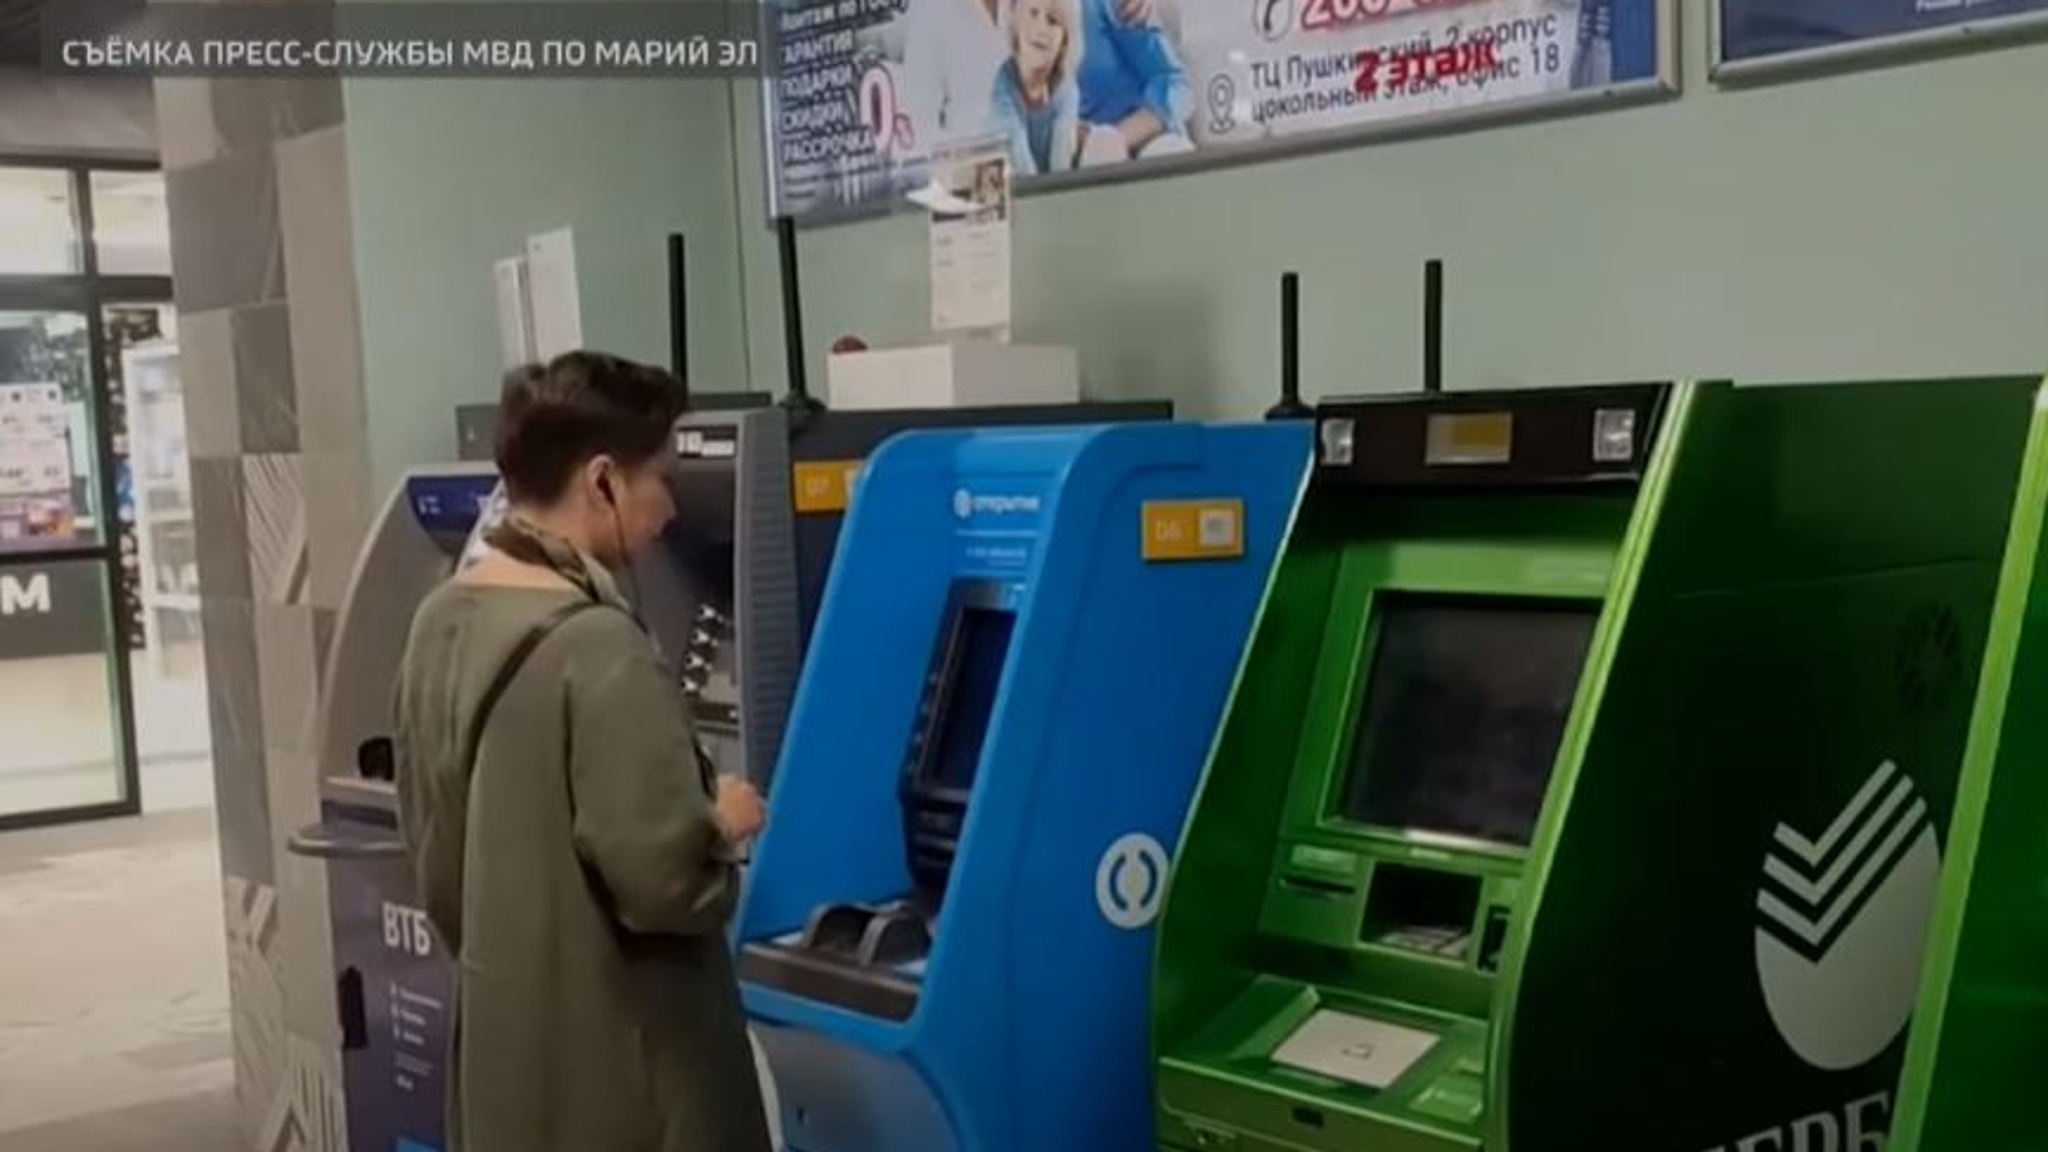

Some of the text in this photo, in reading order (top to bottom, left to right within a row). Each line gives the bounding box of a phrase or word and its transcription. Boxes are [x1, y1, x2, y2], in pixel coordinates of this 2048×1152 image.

[1251, 61, 1281, 90] ТЦ
[1469, 13, 1558, 50] корпус
[1353, 40, 1502, 94] 2 этаж
[1532, 43, 1561, 74] 18
[382, 901, 432, 956] ВТБ
